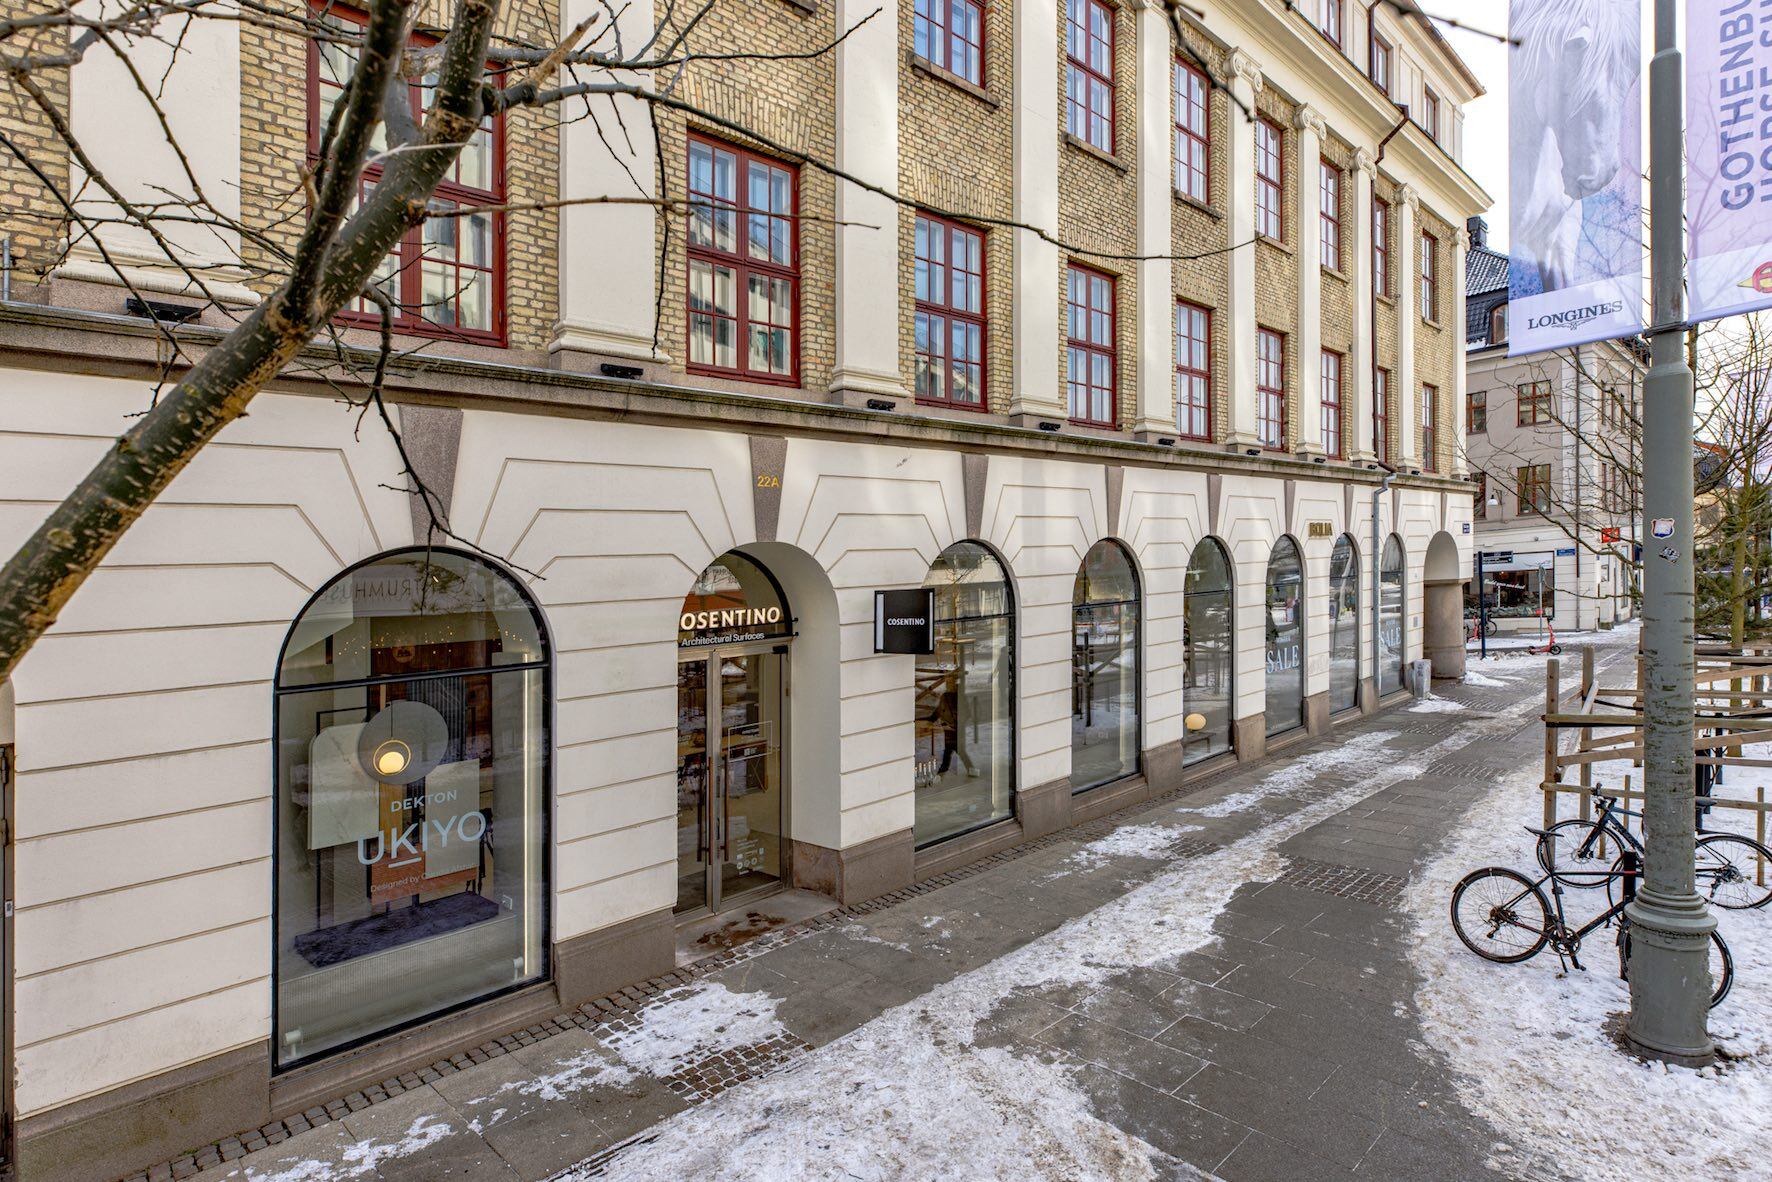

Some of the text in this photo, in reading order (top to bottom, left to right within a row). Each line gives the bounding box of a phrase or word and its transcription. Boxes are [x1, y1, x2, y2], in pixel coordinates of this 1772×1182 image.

[1528, 300, 1623, 330] LONGINES
[757, 474, 779, 488] 22A
[680, 606, 781, 631] OSENTINO
[886, 617, 926, 626] COSENTINO
[681, 631, 766, 647] Architectural Surfaces
[1266, 644, 1300, 674] SALE
[391, 789, 457, 813] DEKTON
[357, 810, 487, 866] UKIYO
[409, 874, 421, 884] by
